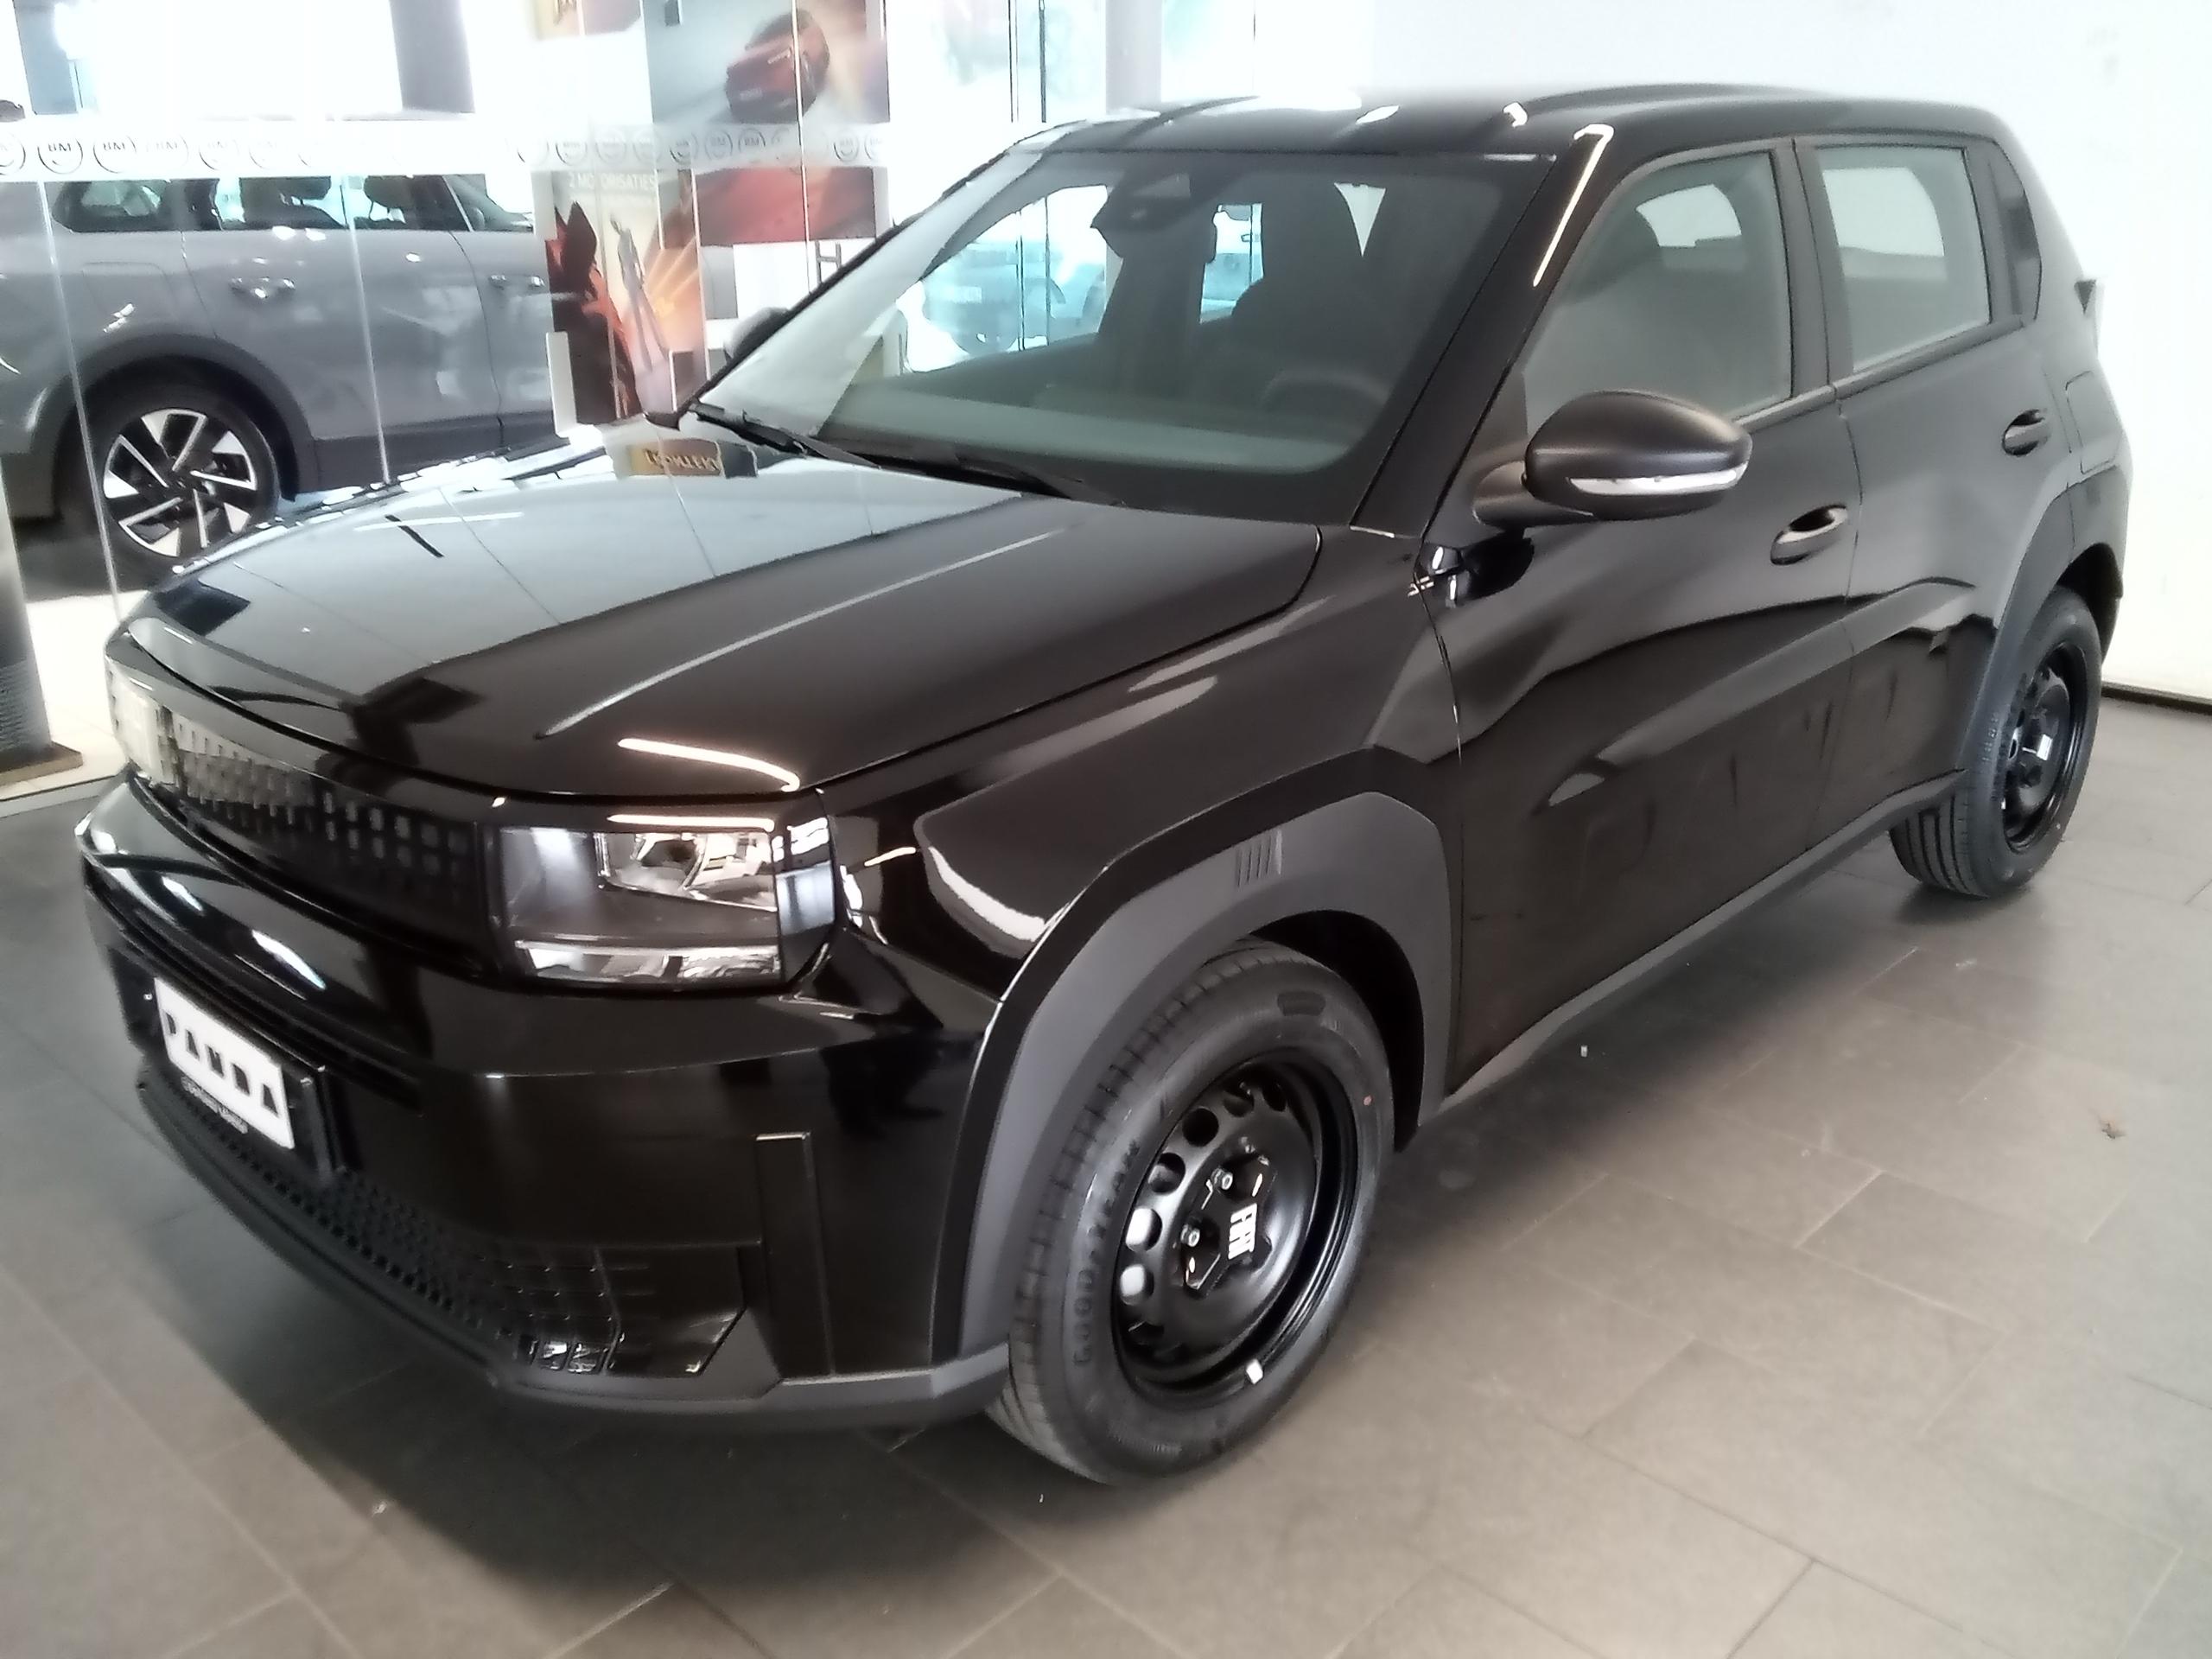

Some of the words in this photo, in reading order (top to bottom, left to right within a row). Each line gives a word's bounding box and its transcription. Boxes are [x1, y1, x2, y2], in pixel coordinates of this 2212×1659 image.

[577, 172, 656, 191] MOORISATIES
[162, 1009, 280, 1118] PANDA
[1228, 1203, 1257, 1260] FIAT
